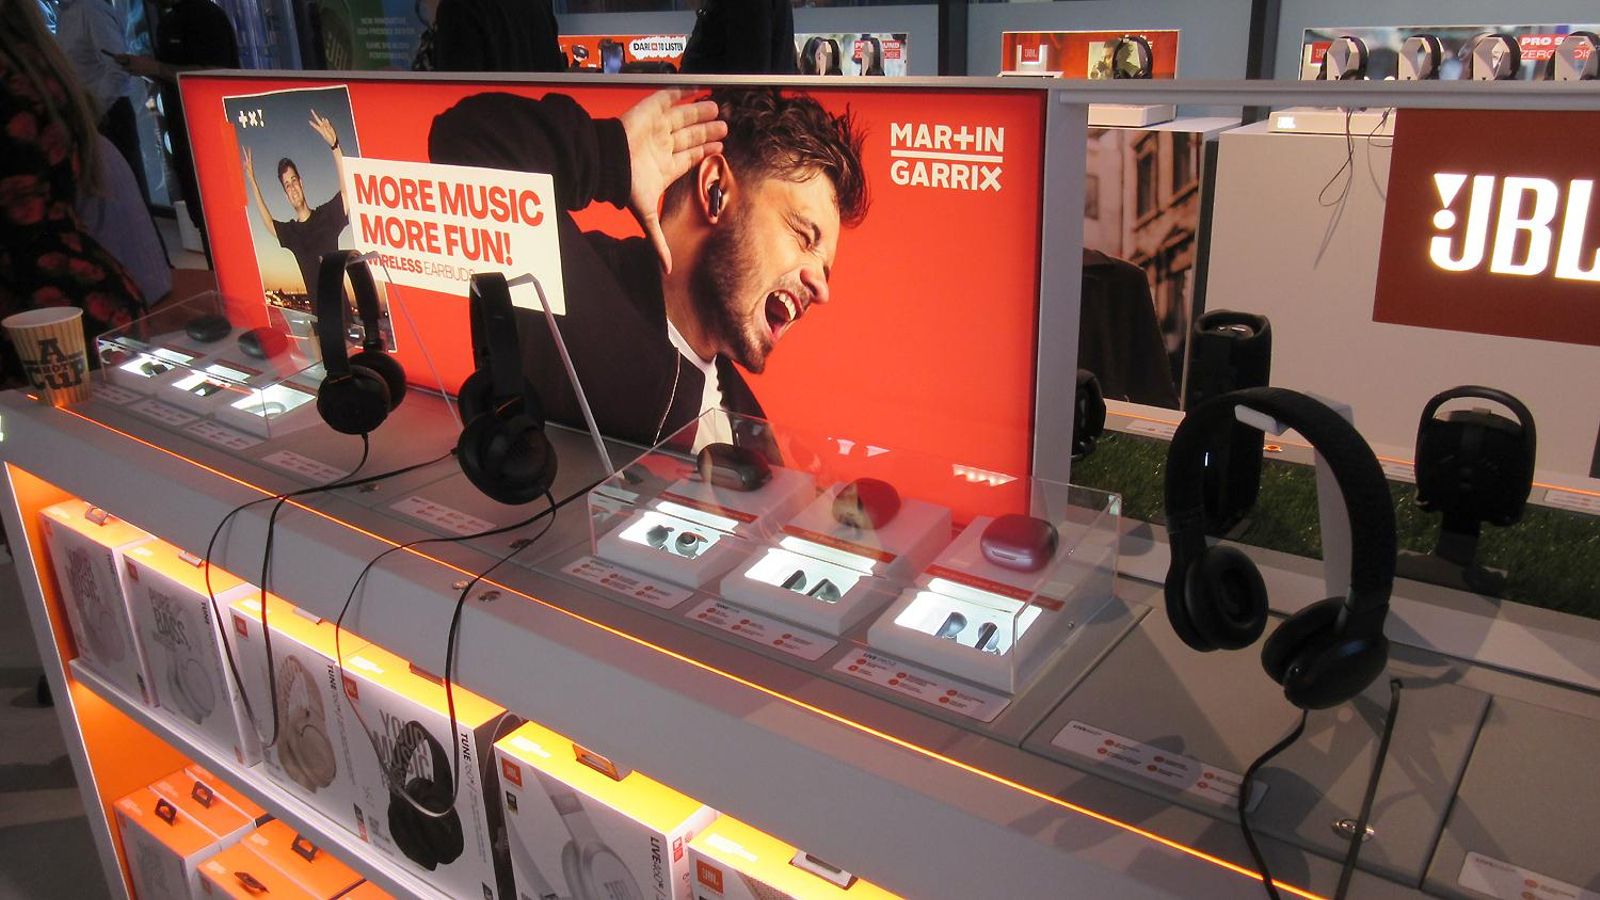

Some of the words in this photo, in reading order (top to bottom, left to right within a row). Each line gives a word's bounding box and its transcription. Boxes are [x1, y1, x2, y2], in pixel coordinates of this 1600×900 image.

[1521, 37, 1552, 46] PRO
[890, 160, 1002, 192] GARRIX
[354, 173, 437, 213] MORE
[438, 181, 544, 227] MUSIC
[360, 213, 442, 255] MORE
[443, 223, 513, 266] FUN!
[1429, 173, 1600, 283] JBL
[366, 252, 423, 274] WIRELESS
[379, 708, 427, 748] YOUR
